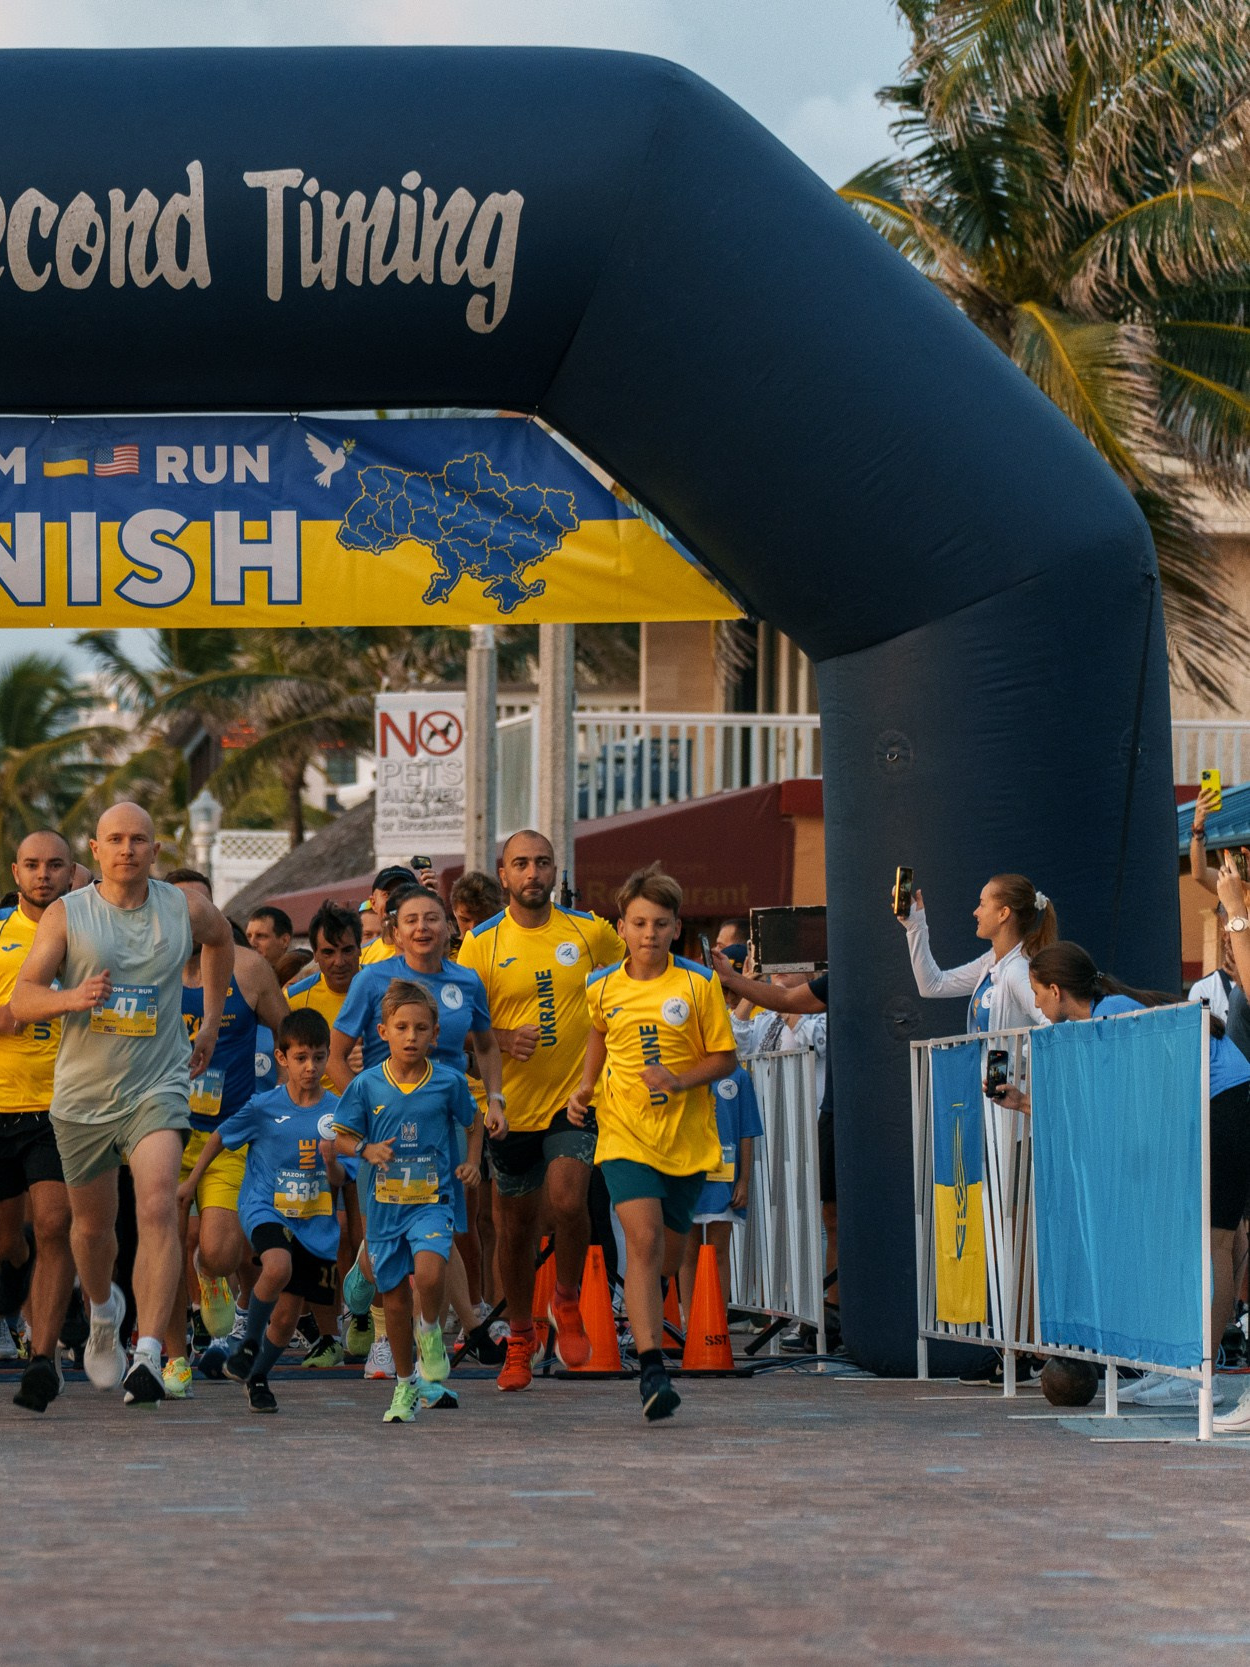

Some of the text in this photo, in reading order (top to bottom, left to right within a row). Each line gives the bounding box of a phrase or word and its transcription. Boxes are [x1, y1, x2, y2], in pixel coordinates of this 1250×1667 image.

[243, 167, 524, 334] Timing
[155, 444, 269, 484] RUN
[378, 760, 464, 787] PETS
[380, 788, 465, 804] ALLOWED
[113, 997, 138, 1019] 47
[535, 968, 557, 1047] UKRAINE
[639, 1023, 668, 1106] UAINE
[400, 1167, 411, 1188] 7
[285, 1180, 320, 1202] 333
[705, 1334, 727, 1346] SST
